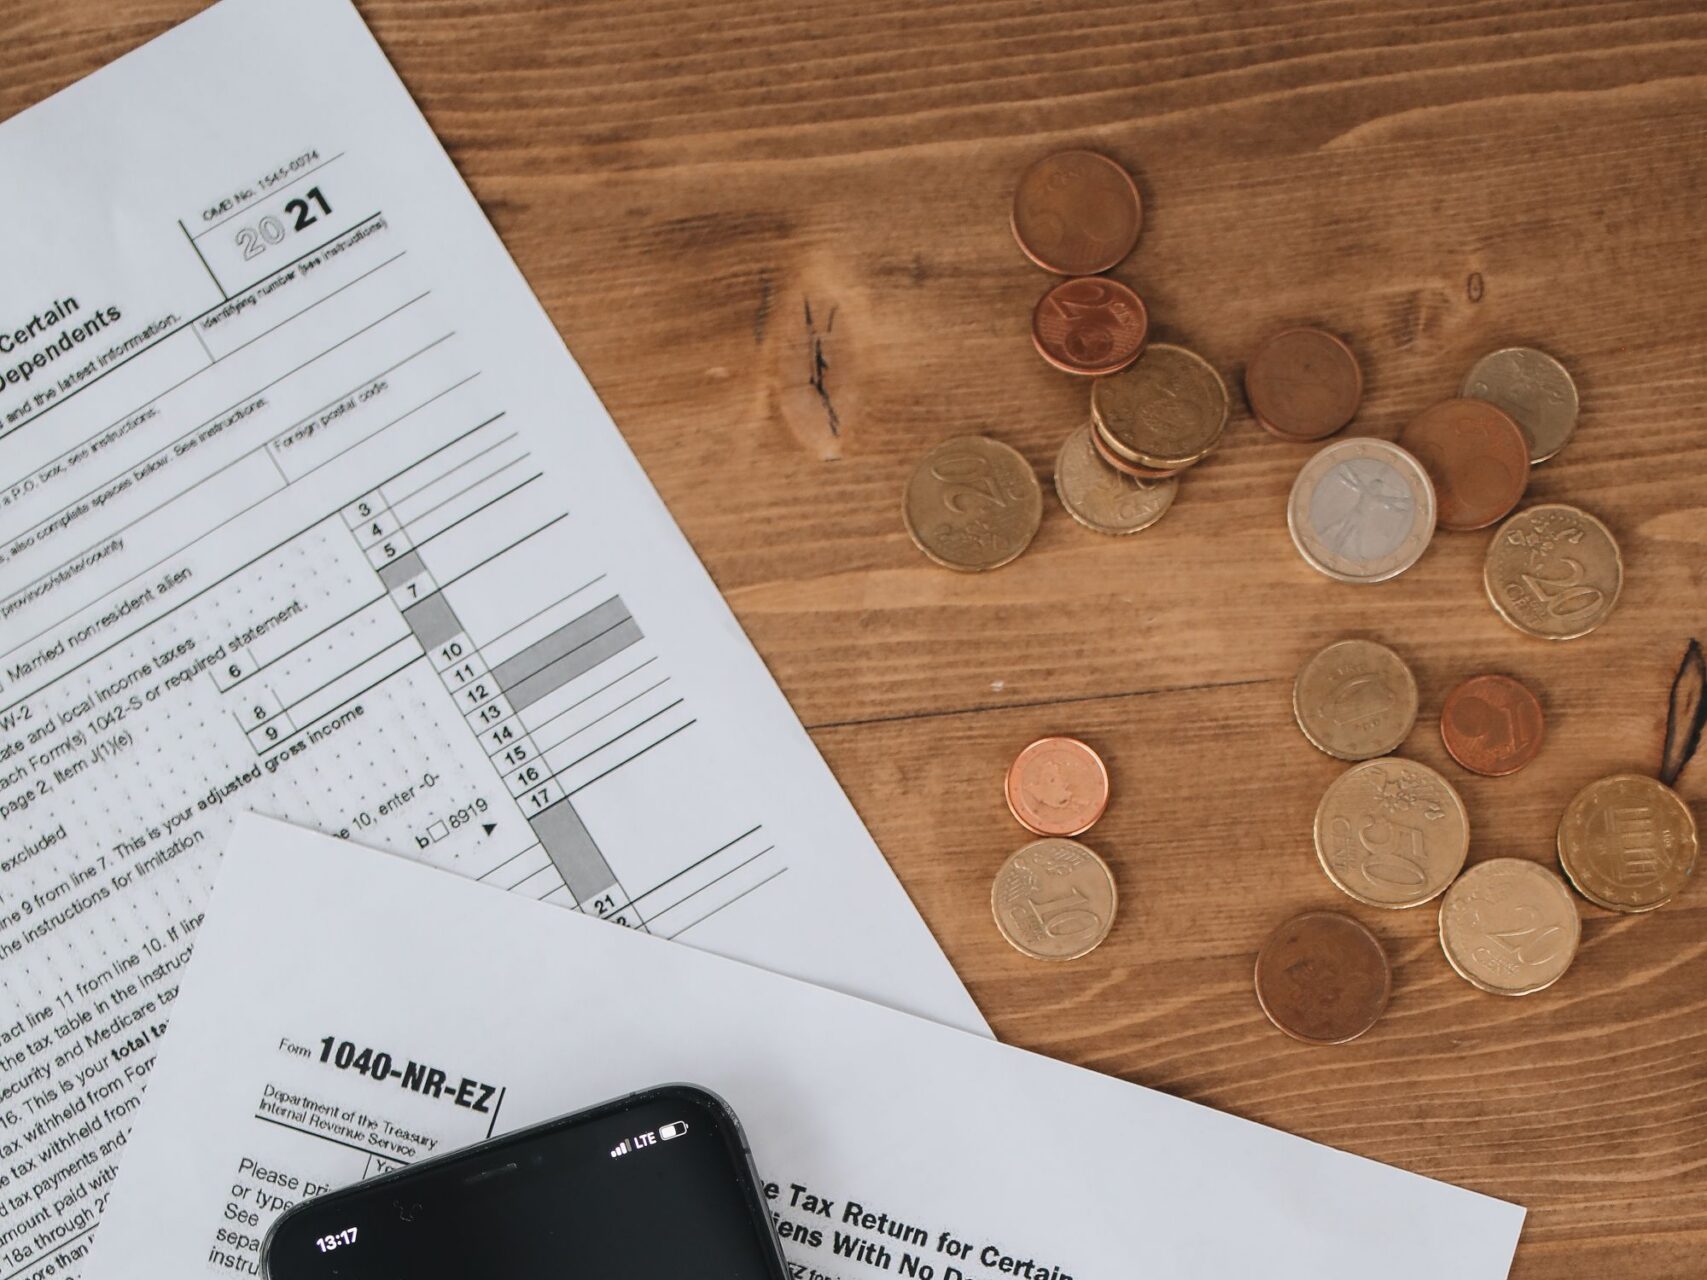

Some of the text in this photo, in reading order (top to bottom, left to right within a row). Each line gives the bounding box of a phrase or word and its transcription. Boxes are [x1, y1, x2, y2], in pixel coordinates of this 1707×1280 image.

[0, 296, 81, 353] Certain
[6, 313, 181, 424] and the latest information.
[357, 501, 372, 518] 3
[406, 583, 417, 598] 7
[1521, 557, 1604, 617] 20
[6, 567, 193, 683] Married nonresident alien
[227, 663, 242, 679] 6
[441, 642, 463, 662] 10
[27, 599, 308, 772] Form(s) 1042-S or required statement.
[252, 704, 267, 721] 8
[264, 725, 279, 741] 9
[111, 704, 365, 859] This is your adjusted gross income
[530, 787, 549, 808] 17
[447, 796, 489, 829] 8919
[0, 823, 68, 873] excluded
[1358, 814, 1429, 889] 50
[21, 829, 205, 944] instructions for limitation
[592, 893, 615, 919] 21
[1027, 886, 1100, 939] 10
[83, 1000, 157, 1049] Medicare
[109, 1029, 151, 1062] total
[277, 1035, 497, 1115] Form 1040-NR-EZ
[258, 1097, 415, 1156] Internal Revenue Service
[262, 1082, 439, 1151] Department of the Treasury
[633, 1131, 657, 1149] LTE
[230, 1183, 253, 1200] or
[237, 1156, 300, 1191] Please
[223, 1201, 259, 1227] See
[789, 1182, 835, 1219] Tax
[841, 1200, 929, 1248] Return
[935, 1231, 974, 1261] for
[316, 1227, 358, 1254] 13:17
[832, 1229, 892, 1271] With
